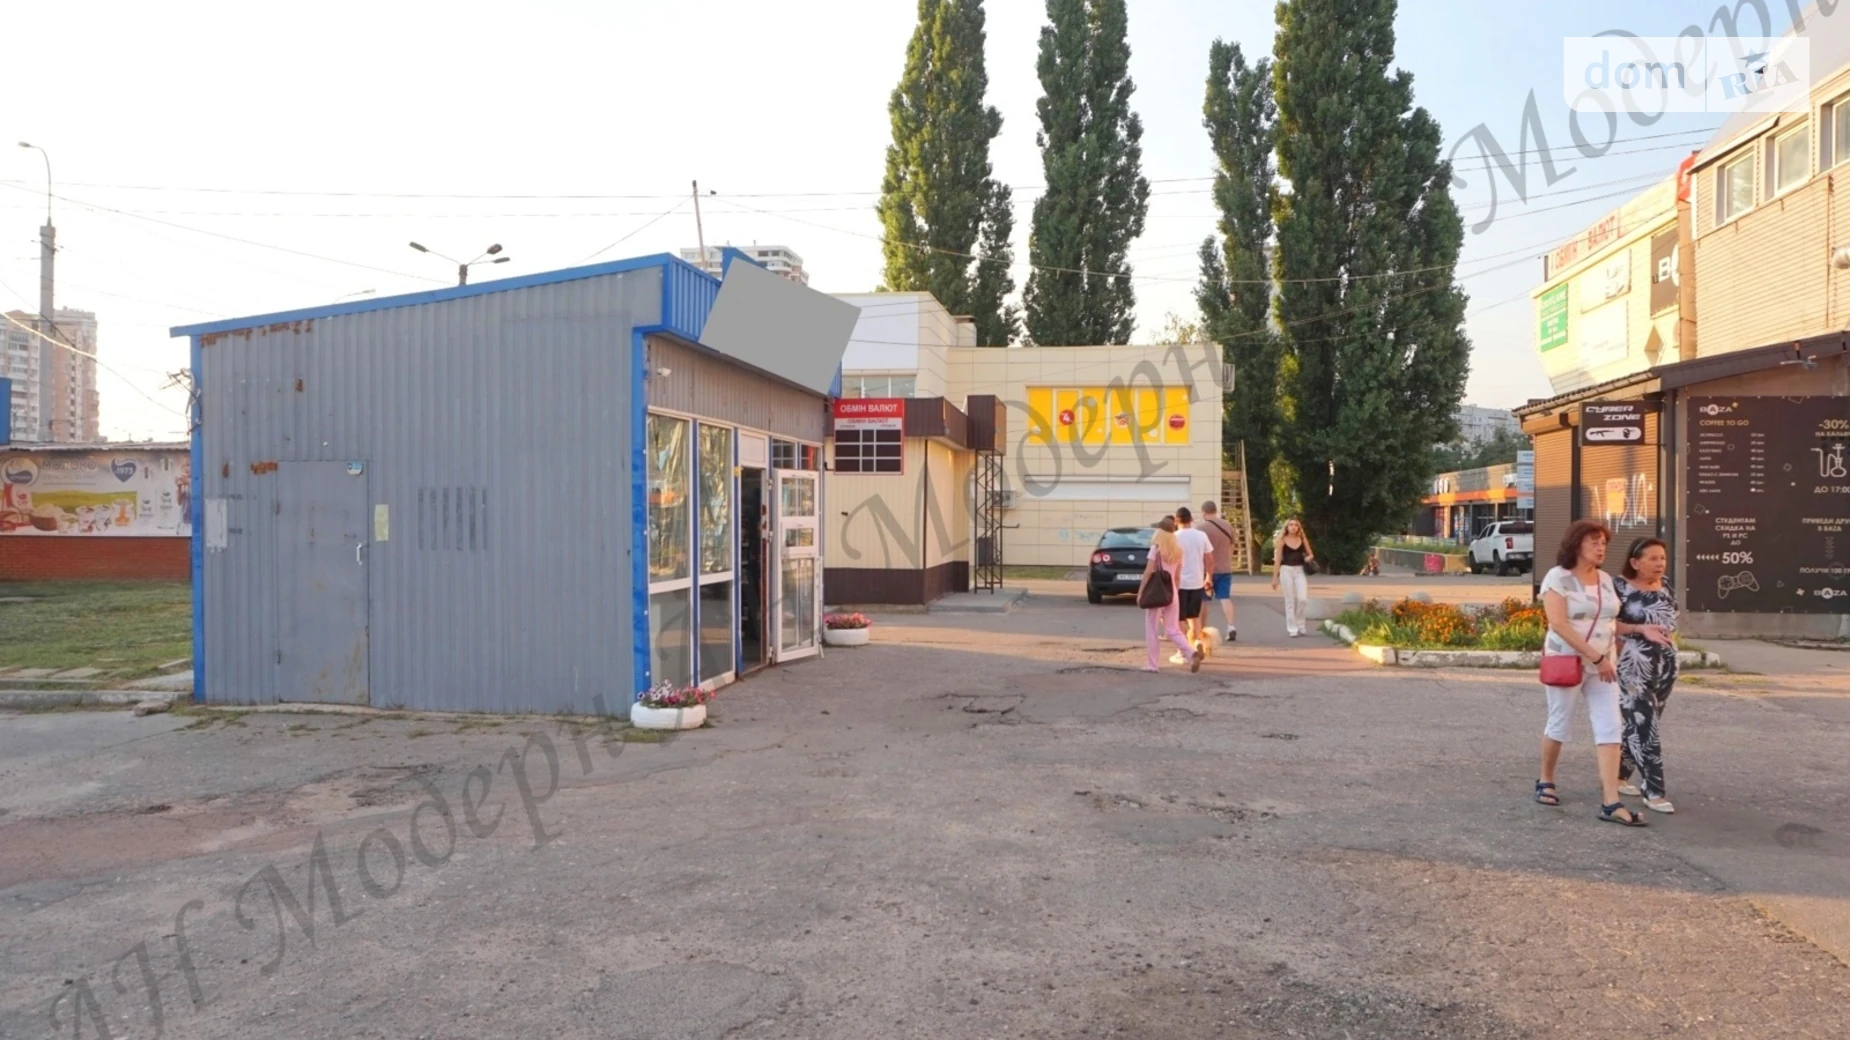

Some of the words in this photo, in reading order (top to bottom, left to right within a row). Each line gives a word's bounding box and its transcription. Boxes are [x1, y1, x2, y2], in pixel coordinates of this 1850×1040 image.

[840, 404, 866, 413] ОБМІН
[867, 403, 898, 413] ВАЛЮТ
[1585, 405, 1634, 414] CYBER
[1603, 413, 1641, 421] ZONE
[1818, 419, 1850, 430] -30%
[116, 466, 133, 476] 1973
[1814, 486, 1828, 494] ДО
[1715, 517, 1756, 525] СТУДЕНТАМ
[1721, 551, 1754, 564] 50%
[1813, 587, 1848, 599] BAZA
